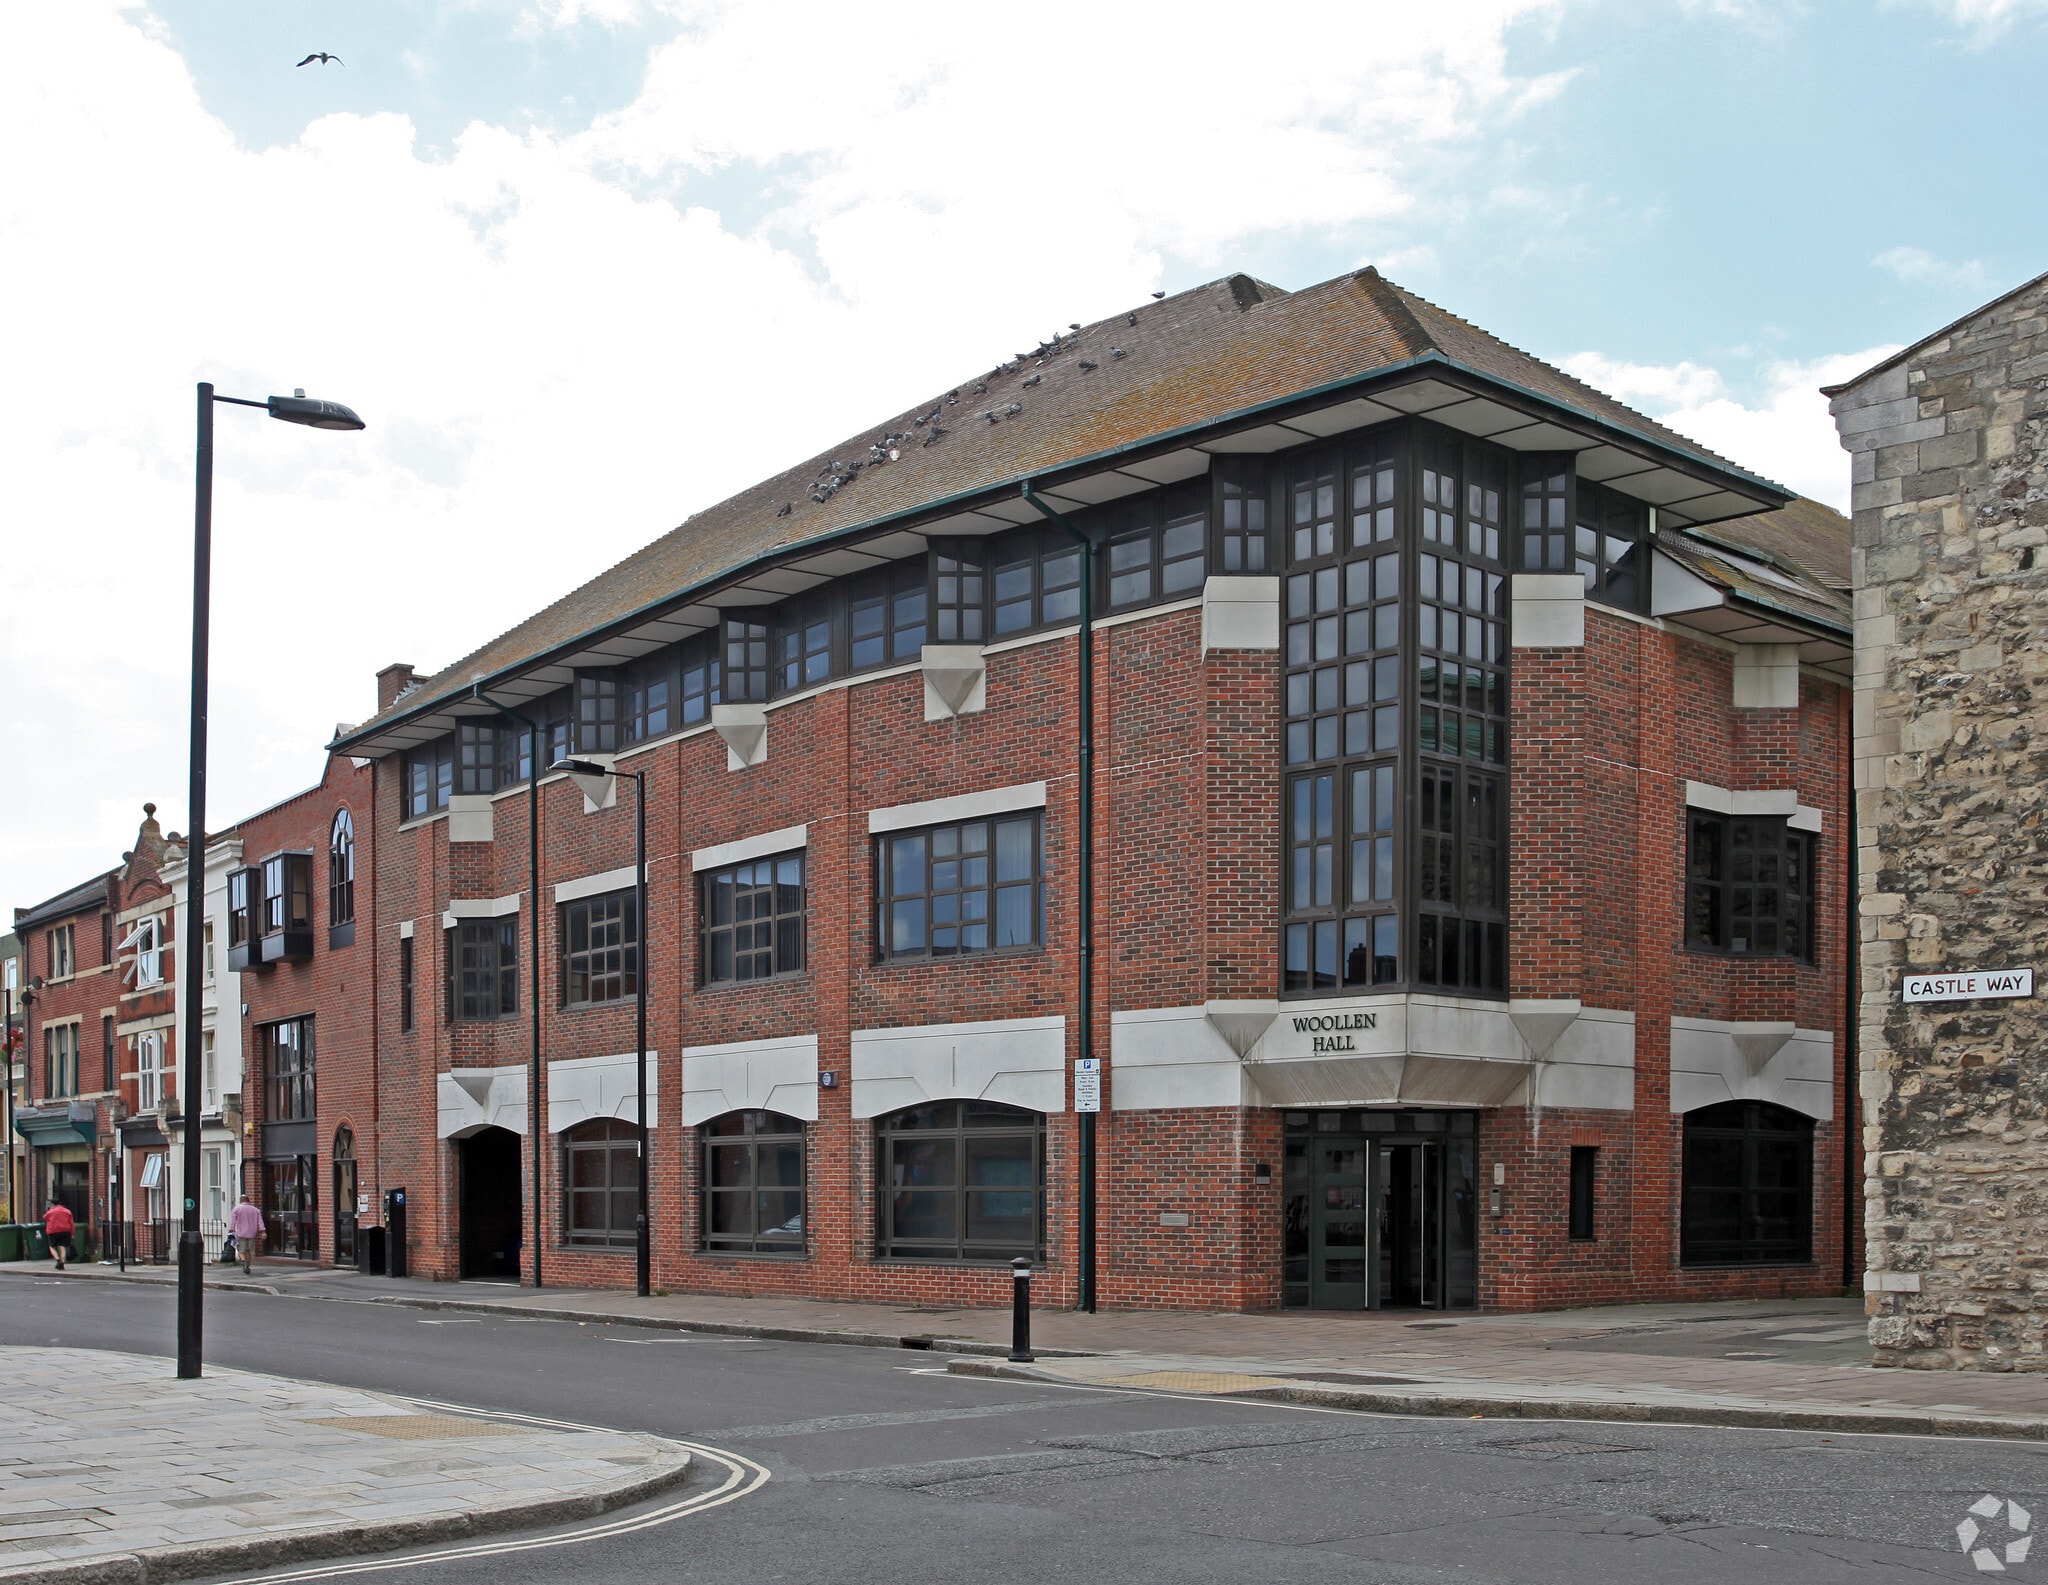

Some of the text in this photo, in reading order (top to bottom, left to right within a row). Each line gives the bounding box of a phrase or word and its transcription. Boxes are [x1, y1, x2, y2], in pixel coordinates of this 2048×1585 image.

[1910, 975, 2025, 995] CASTLE WAY
[1292, 1013, 1376, 1032] WOOLLEN
[1312, 1035, 1355, 1052] HALL
[396, 1193, 404, 1203] P
